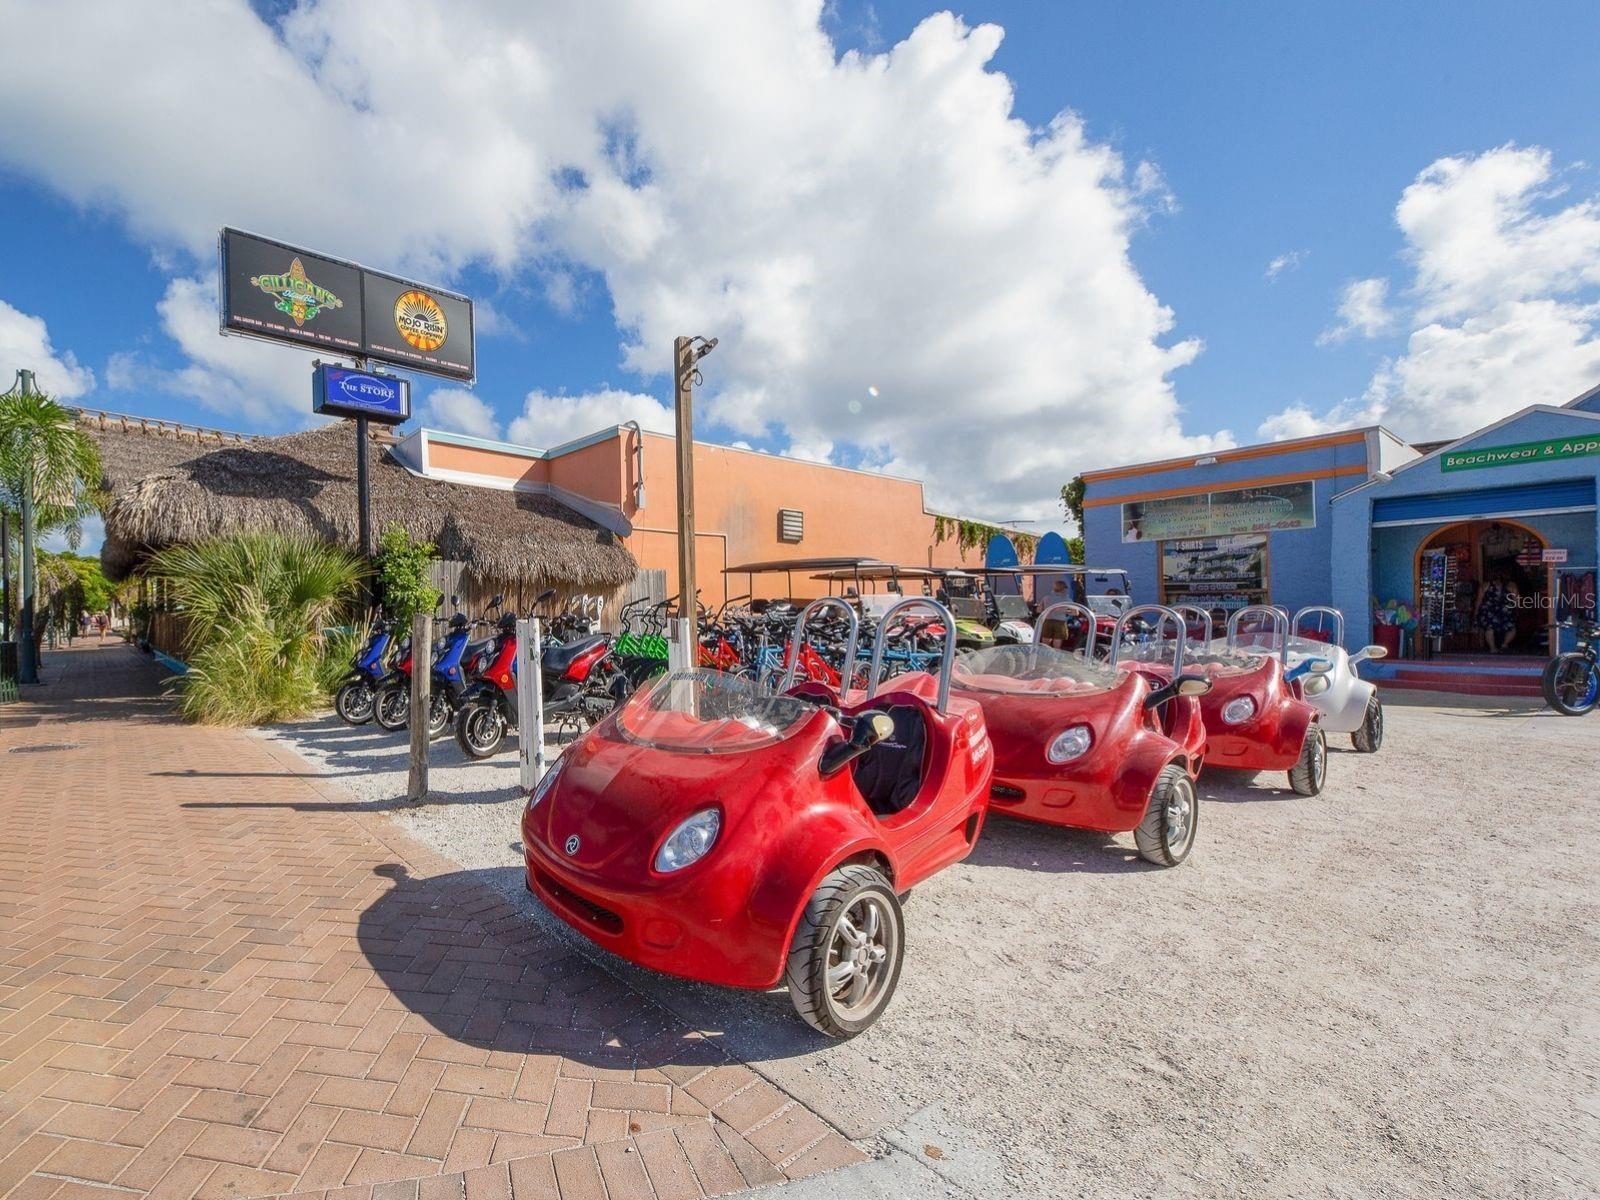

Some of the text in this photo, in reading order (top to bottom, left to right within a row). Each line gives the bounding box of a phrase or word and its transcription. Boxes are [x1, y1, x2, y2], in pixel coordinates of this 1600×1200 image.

[399, 316, 421, 328] MOJO
[360, 384, 395, 398] STORE
[1447, 441, 1600, 466] Beachwear & App
